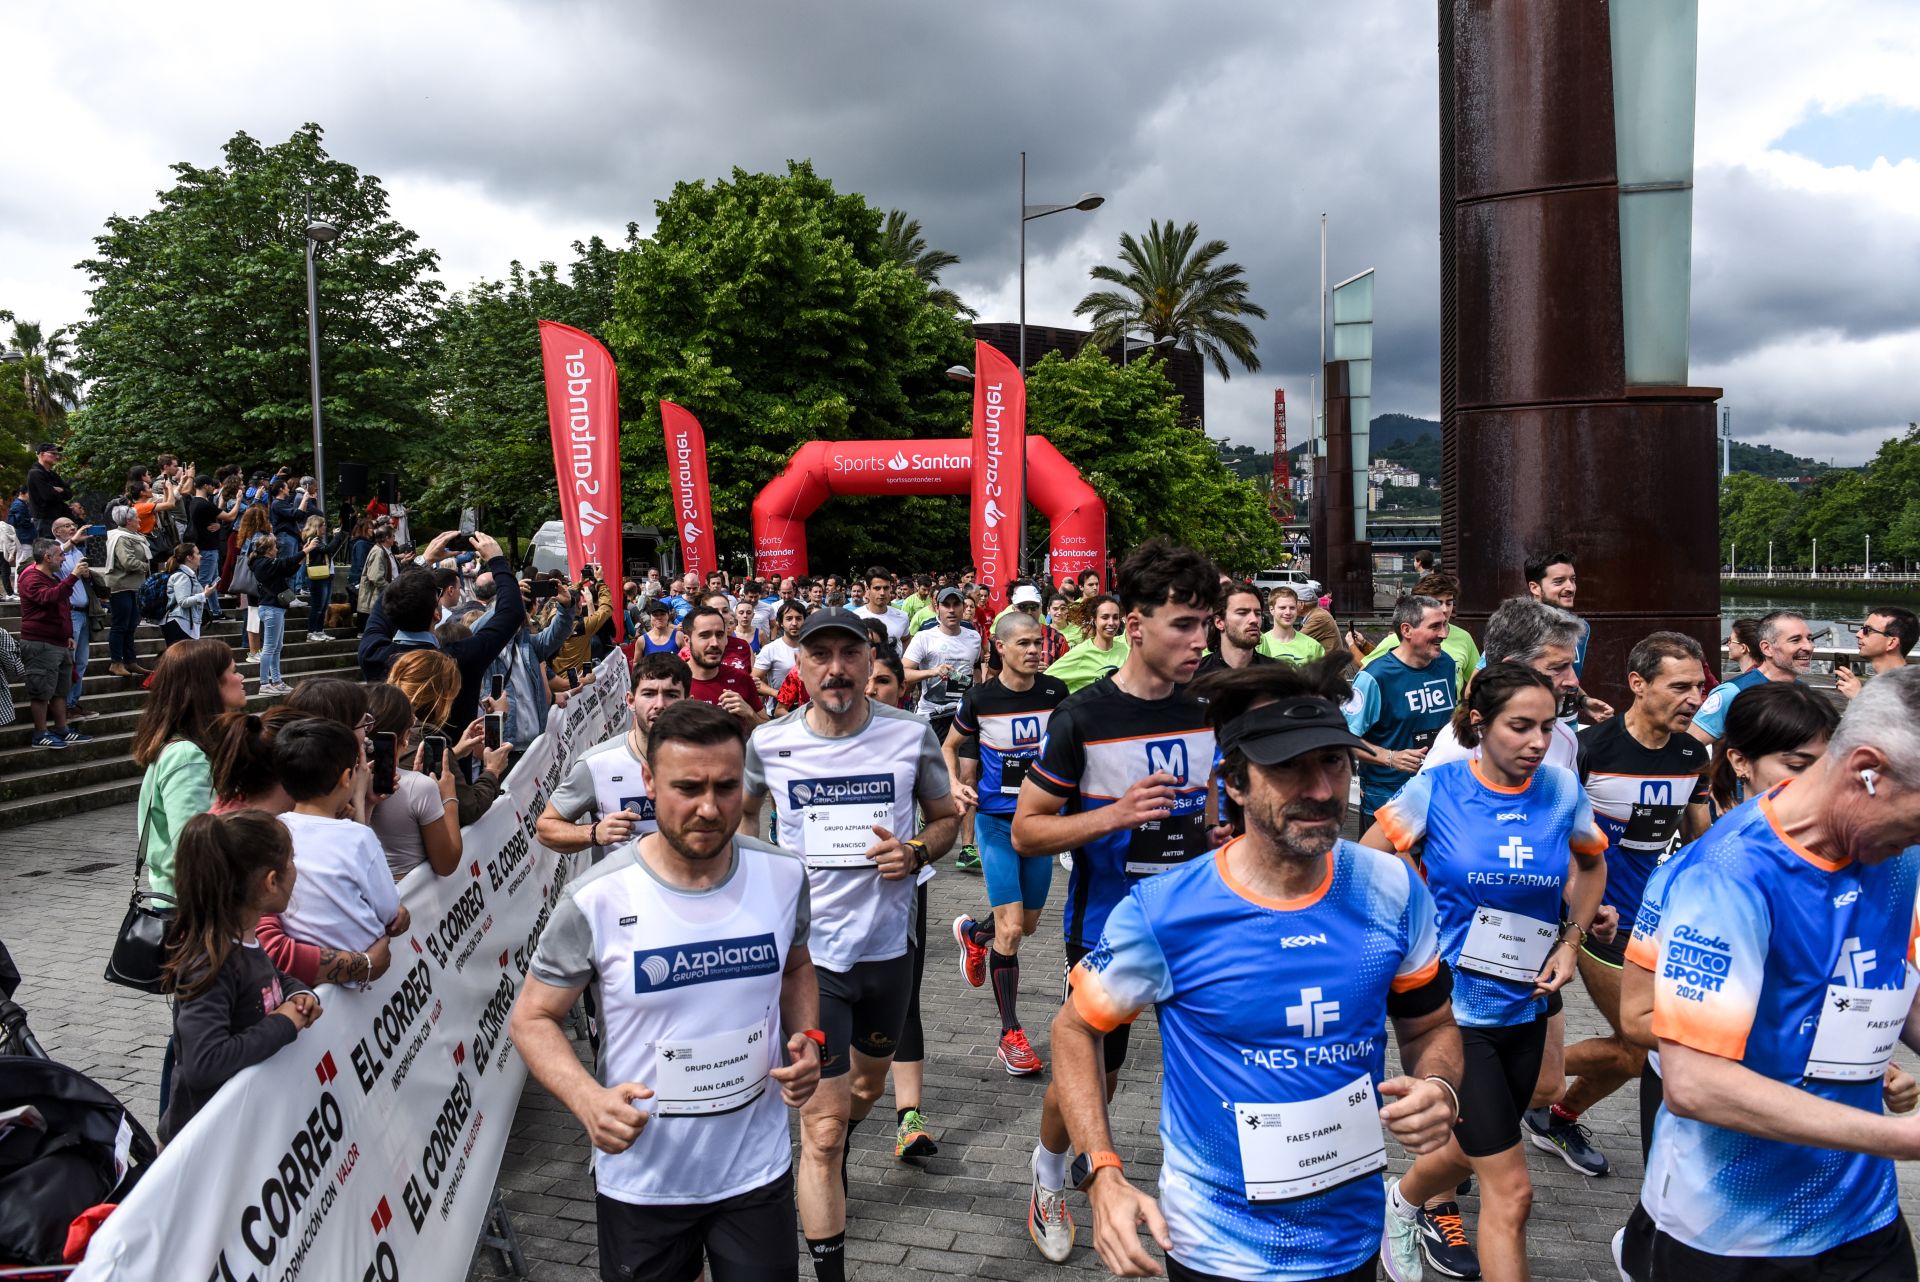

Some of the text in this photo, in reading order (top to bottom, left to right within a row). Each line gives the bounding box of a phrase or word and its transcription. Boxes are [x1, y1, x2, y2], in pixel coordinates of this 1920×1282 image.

[834, 453, 973, 475] Sports Santan
[886, 476, 942, 485] sportssantander.es
[758, 536, 782, 546] Sports
[1060, 535, 1087, 546] Sports
[758, 548, 795, 557] Santander
[1058, 548, 1098, 557] Santander
[813, 780, 892, 802] Azpiaran
[873, 810, 888, 818] 601
[1167, 833, 1184, 841] MESA
[486, 860, 504, 892] EL
[1467, 871, 1560, 888] FAES FARMA
[425, 881, 485, 970] EL CORREO
[1537, 927, 1553, 938] 586
[1498, 933, 1513, 942] FAES
[1673, 924, 1731, 952] Ricola
[672, 943, 775, 976] Azpiaran
[1501, 952, 1519, 961] SILVIA
[1668, 944, 1727, 973] GLUCO
[672, 969, 704, 982] GRUPO
[709, 965, 740, 975] Stamping
[1663, 963, 1725, 992] SPORT
[1676, 984, 1705, 1003] 2024
[350, 958, 433, 1096] EL CORREO
[472, 972, 515, 1077] EL CORREO
[1866, 1020, 1889, 1029] FAES
[391, 999, 443, 1093] INFORMACIÓN CON VALOR
[747, 1029, 763, 1045] 601
[684, 1053, 749, 1073] GRUPO AZPIARAN
[1240, 1037, 1375, 1070] FAES FARMA
[692, 1075, 745, 1093] JUAN CARLOS
[1348, 1088, 1368, 1107] 586
[1286, 1123, 1342, 1144] FAES FARMA
[402, 1071, 472, 1235] EL CORREO
[1298, 1149, 1338, 1168] GERMÁN
[240, 1091, 343, 1266] CORREO
[321, 1180, 338, 1218] CON
[335, 1142, 360, 1186] VALOR
[439, 1156, 466, 1222] INFORMAZIO
